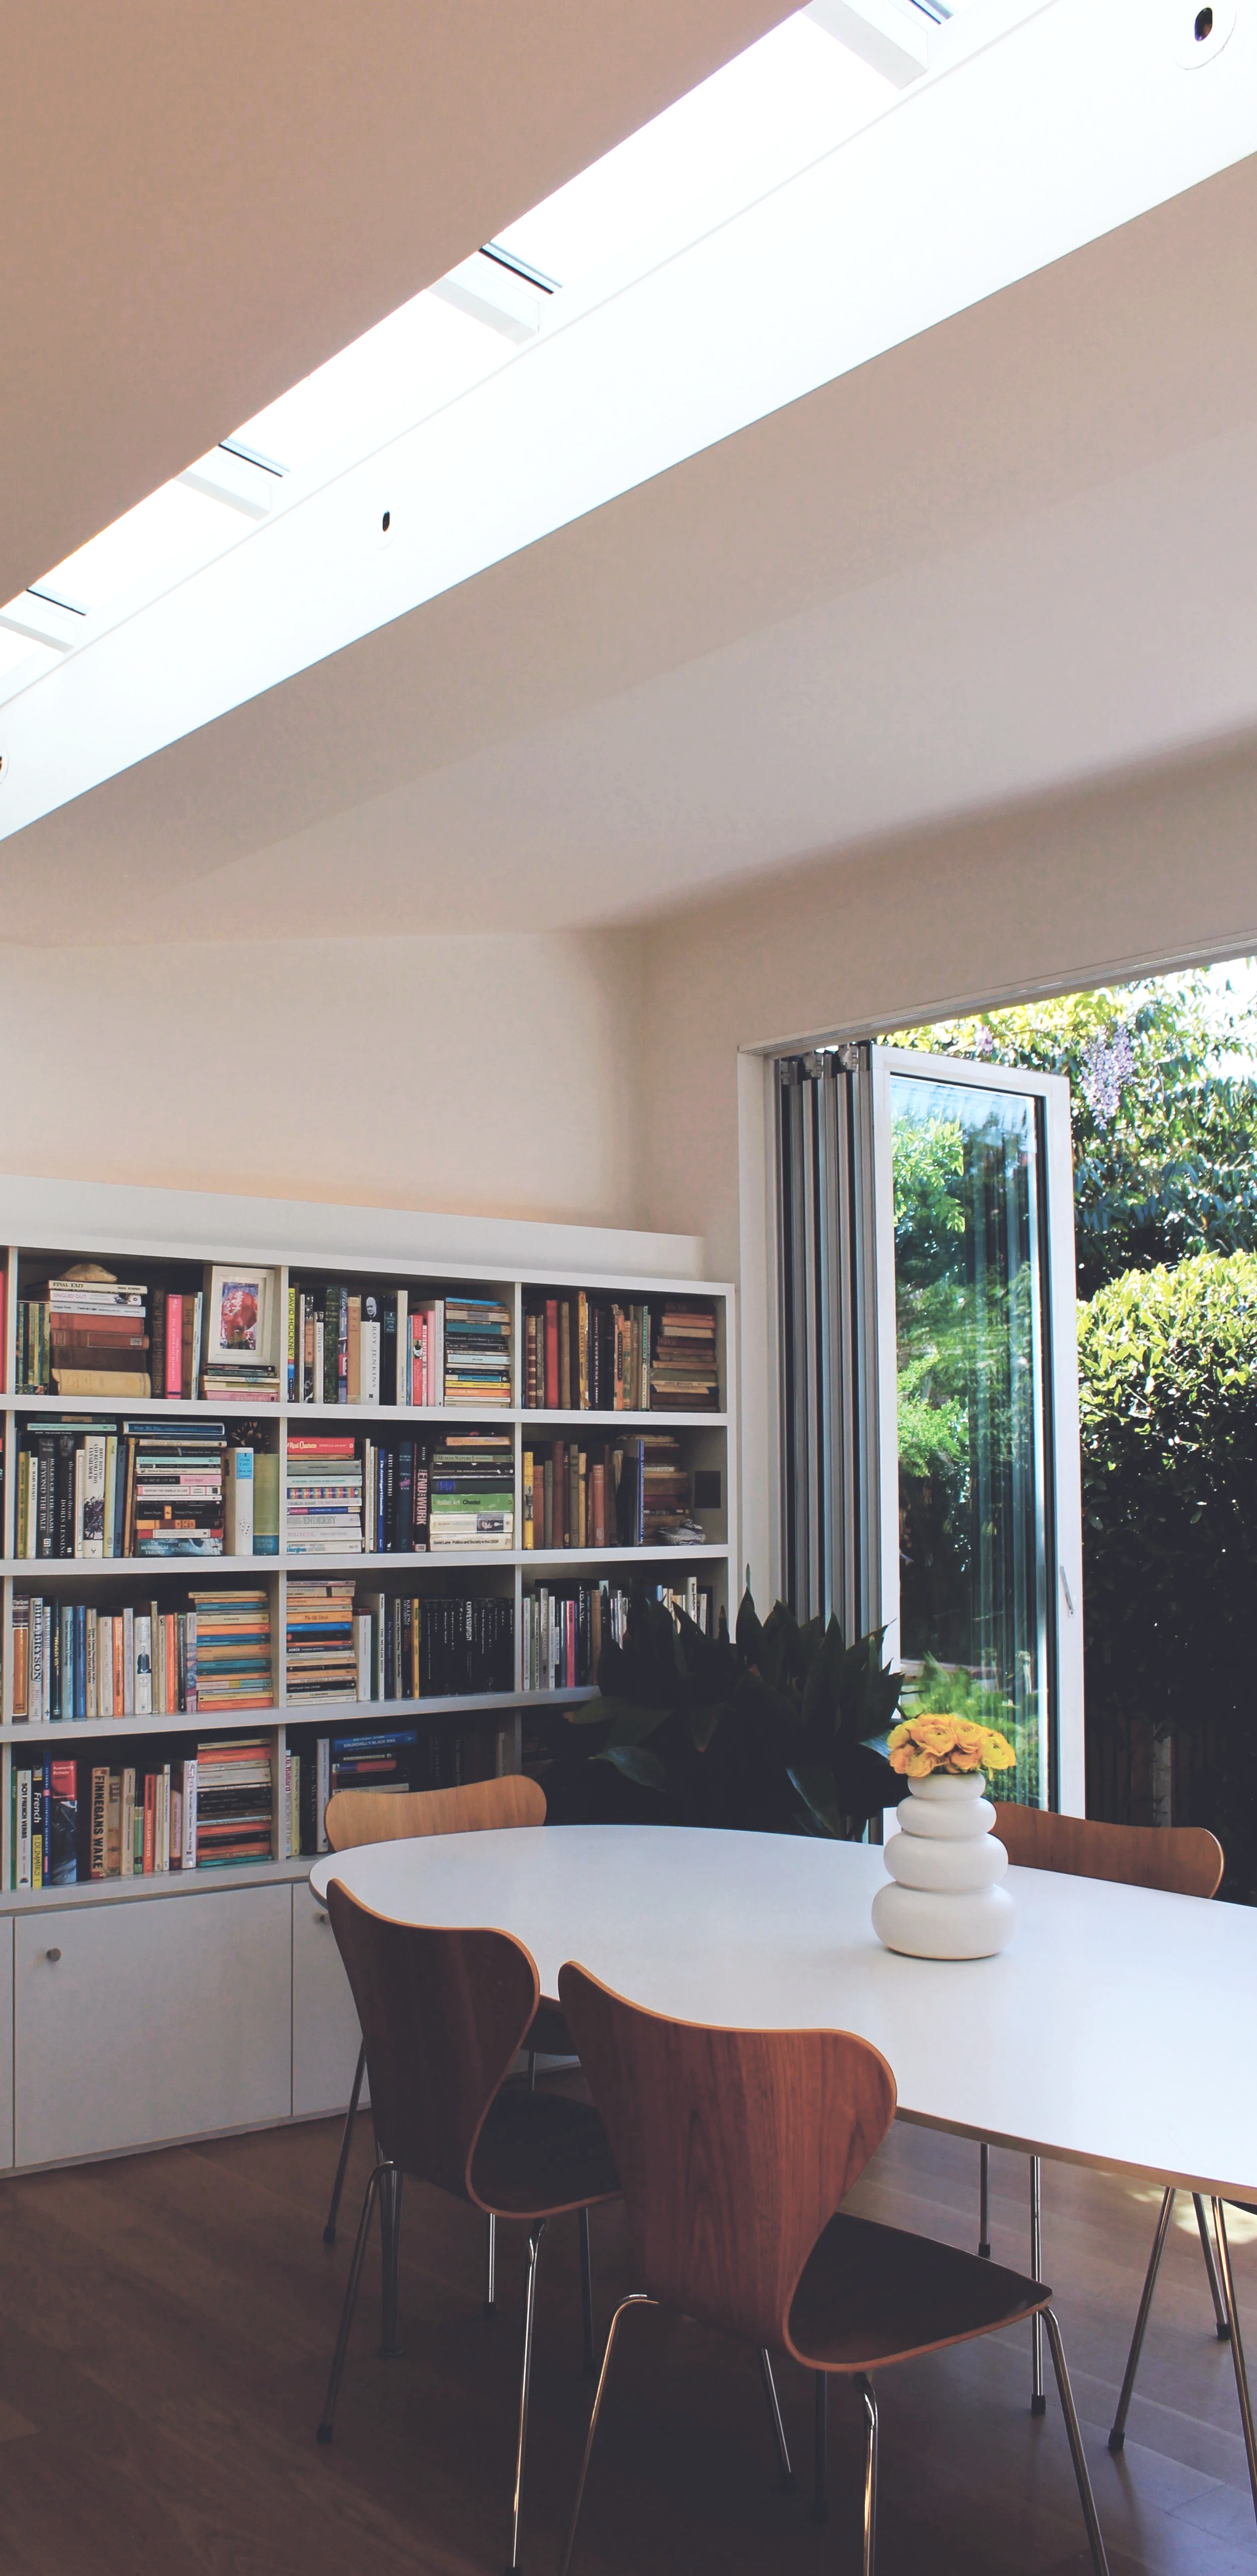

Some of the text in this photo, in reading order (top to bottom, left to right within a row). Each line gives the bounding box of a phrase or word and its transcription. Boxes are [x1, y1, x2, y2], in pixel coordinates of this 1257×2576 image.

[49, 1482, 54, 1492] OF
[418, 1472, 428, 1493] END
[303, 1516, 336, 1525] ENDERBY
[416, 1496, 427, 1525] WORK
[34, 1792, 42, 1823] French
[93, 1775, 105, 1869] FINNEGANS WAKE
